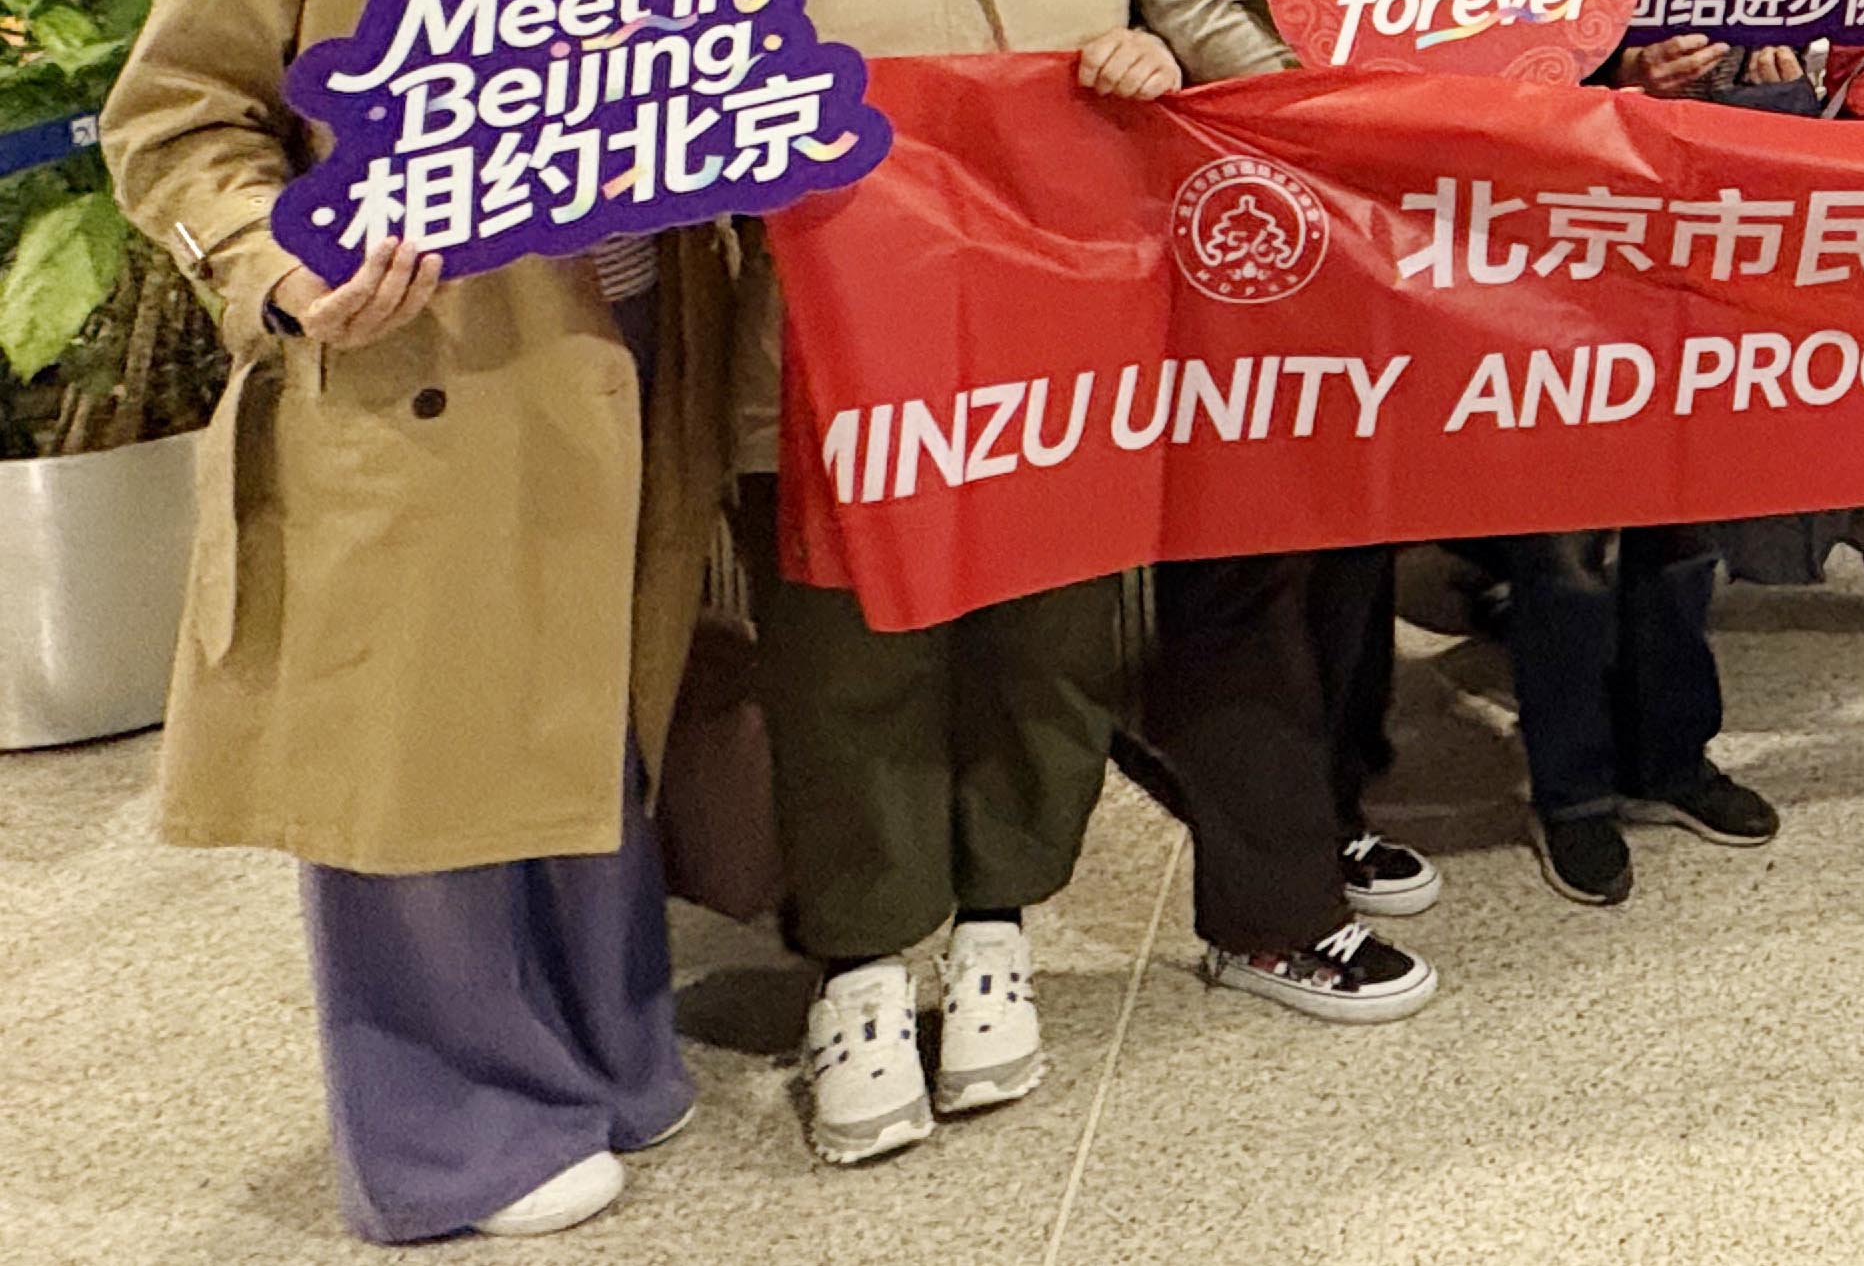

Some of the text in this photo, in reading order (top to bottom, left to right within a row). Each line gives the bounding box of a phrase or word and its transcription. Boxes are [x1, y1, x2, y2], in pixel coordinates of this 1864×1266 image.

[389, 22, 758, 154] Beijing
[338, 74, 858, 252] 相约北京
[1111, 355, 1411, 451] UNITY
[1444, 342, 1656, 433] AND
